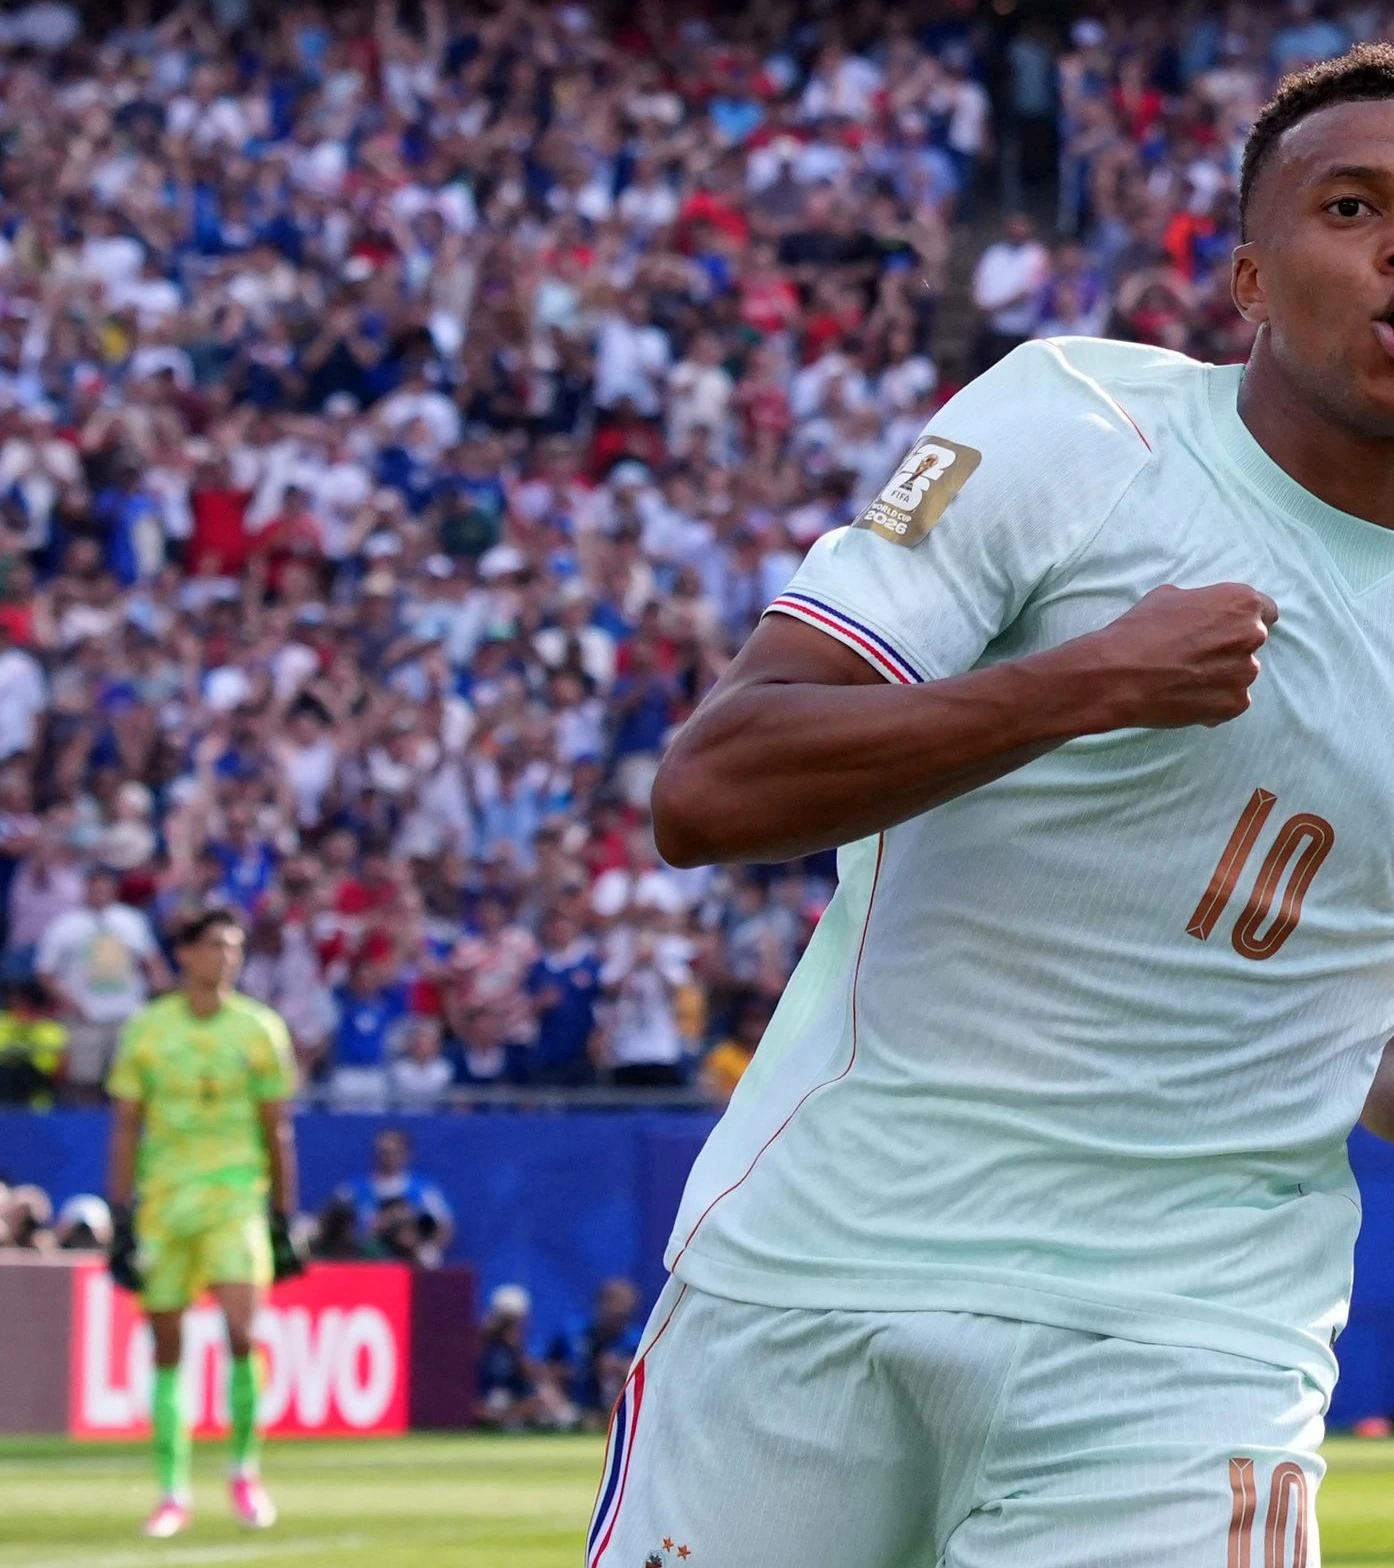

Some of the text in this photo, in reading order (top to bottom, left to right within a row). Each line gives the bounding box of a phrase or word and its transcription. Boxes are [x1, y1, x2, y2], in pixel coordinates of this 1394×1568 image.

[890, 490, 910, 503] FIFA
[864, 510, 908, 535] 2026
[897, 512, 912, 523] CUP
[1185, 787, 1335, 961] 10
[1226, 1457, 1308, 1568] 10
